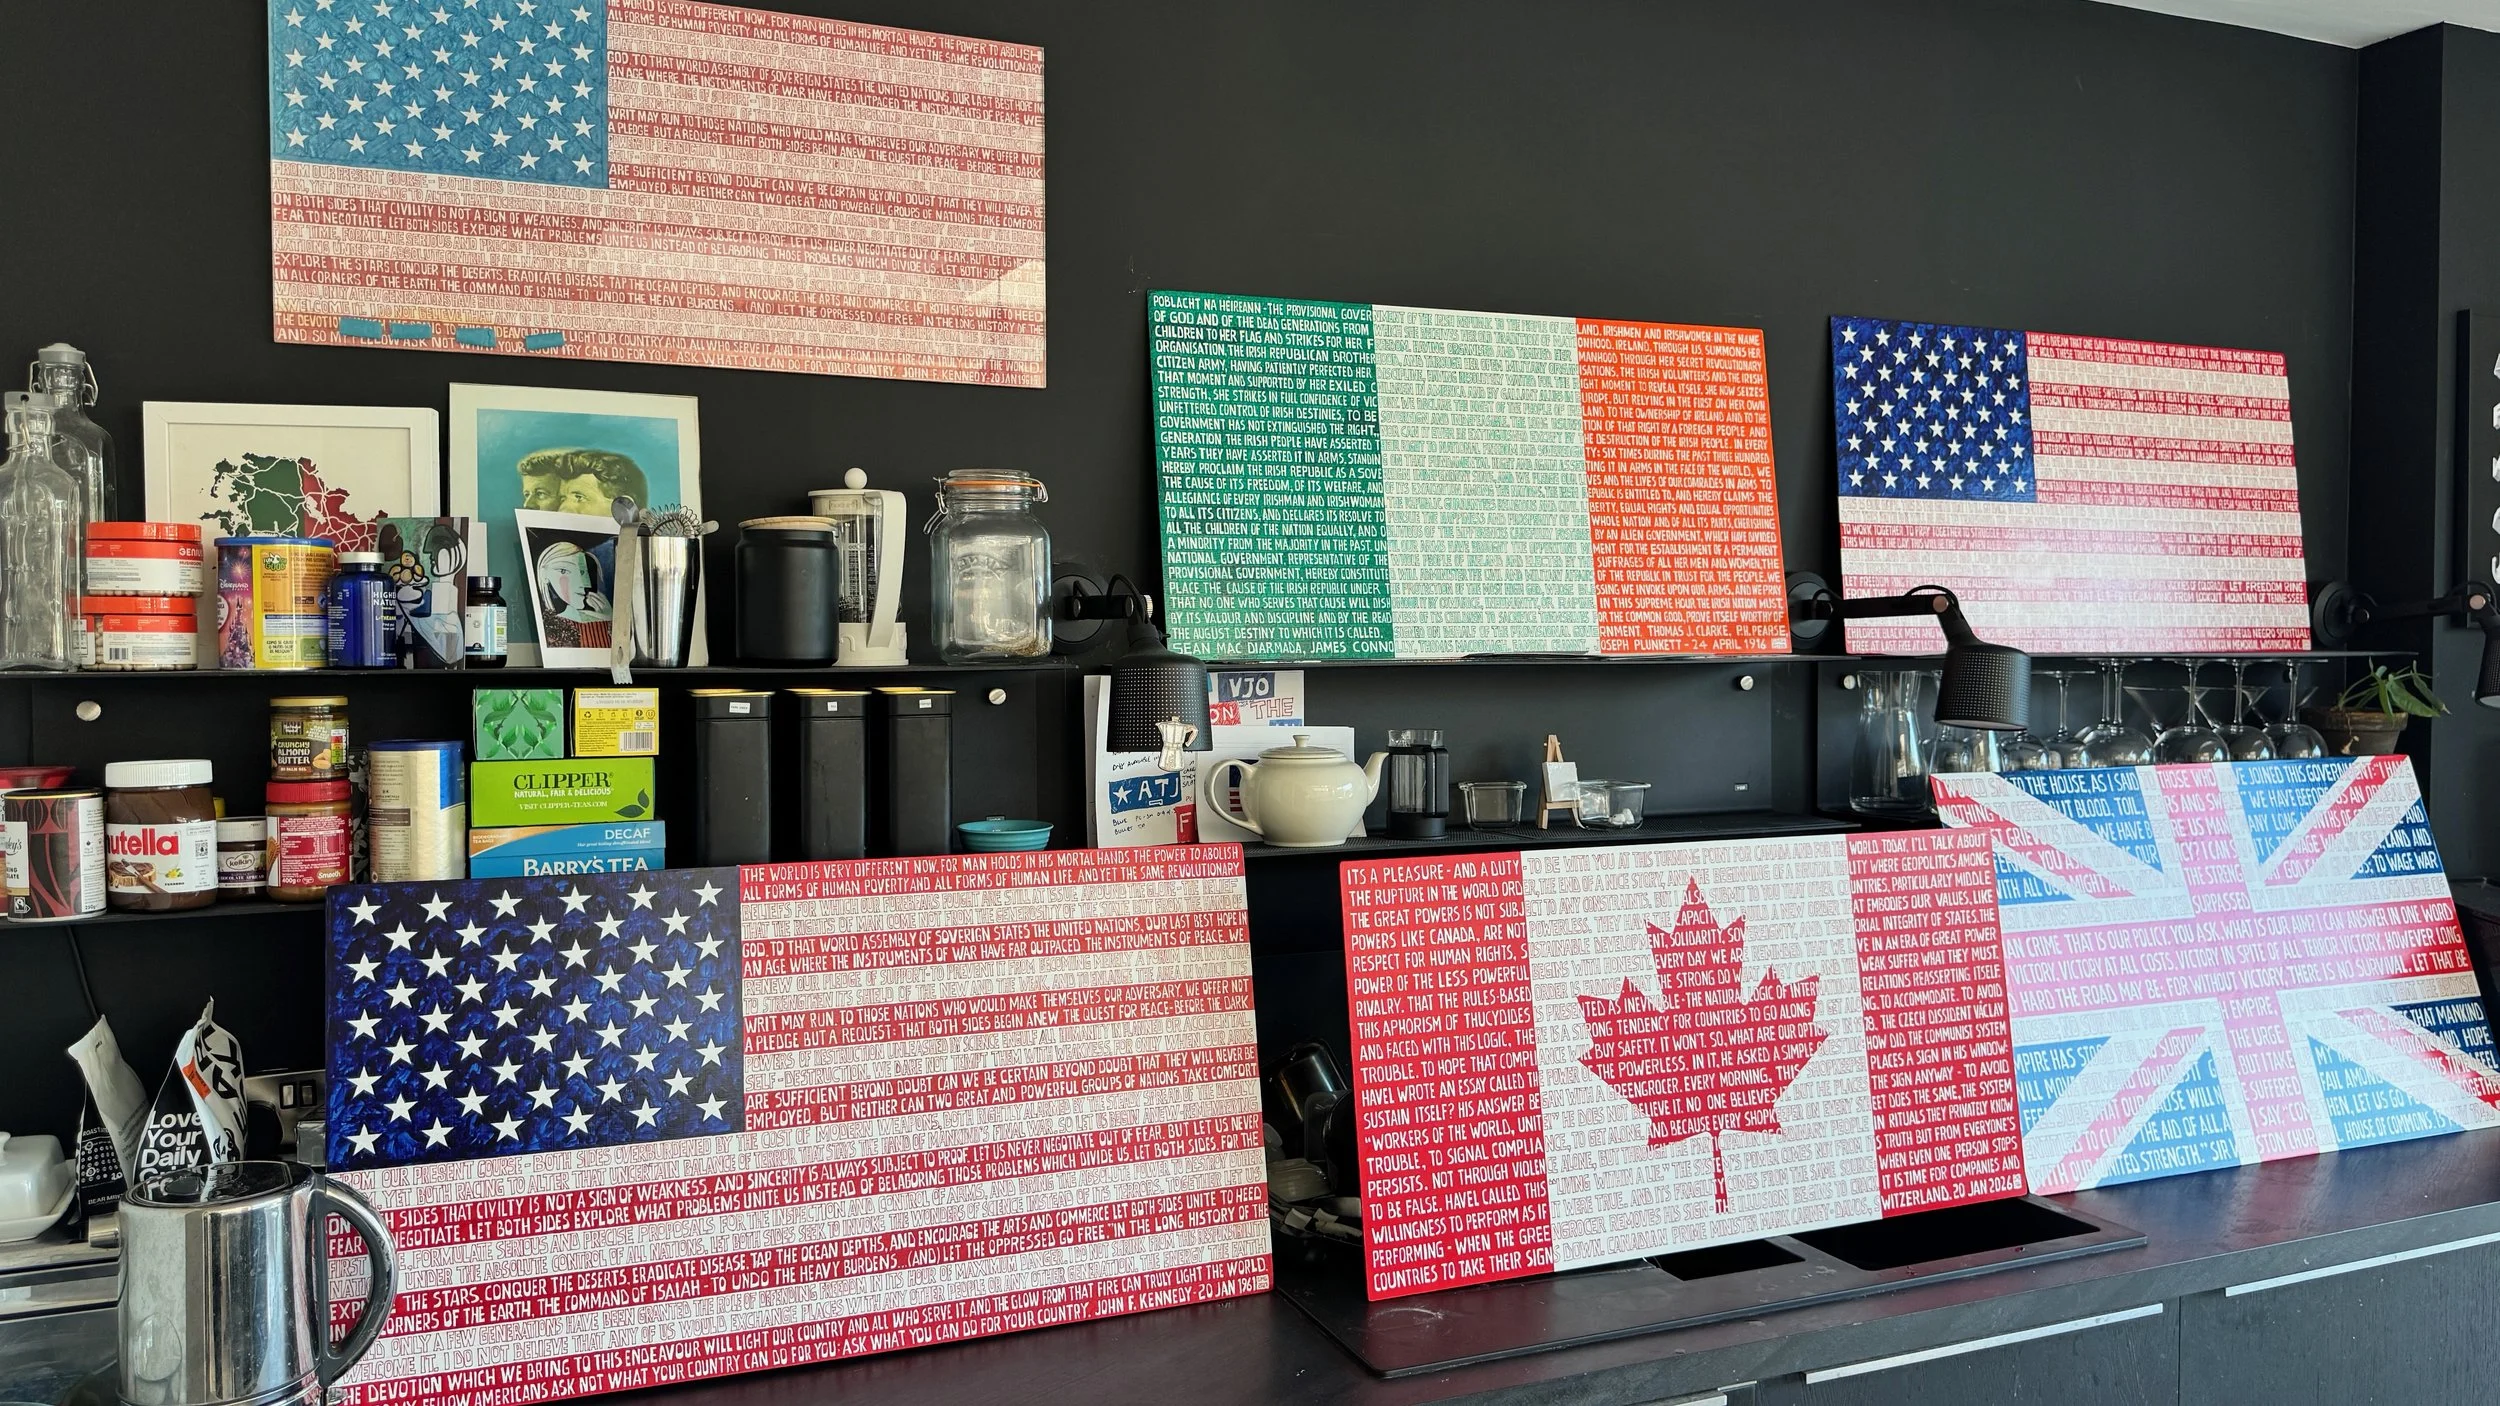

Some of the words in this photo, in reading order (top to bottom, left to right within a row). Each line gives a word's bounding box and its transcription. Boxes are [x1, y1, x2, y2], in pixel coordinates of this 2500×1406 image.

[676, 59, 708, 74] WORLD
[711, 62, 755, 79] ASSEMBLY
[771, 69, 820, 87] SOVEREIGN
[296, 194, 324, 209] BOTH
[327, 197, 356, 212] SIDES
[361, 199, 386, 214] THAT
[390, 201, 434, 217] CIVILITY
[275, 252, 326, 268] EXPLORE
[1153, 295, 1200, 310] POBLACHT
[1204, 299, 1216, 311] NA
[1286, 304, 1337, 319] PROVISIONAL
[1154, 325, 1203, 339] CHILDREN
[1219, 329, 1236, 341] HER
[1239, 330, 1261, 342] FLAG
[1285, 333, 1324, 346] STRIKES
[1326, 336, 1342, 348] FOR
[1619, 353, 1656, 366] THROUGH
[1658, 355, 1674, 367] HER
[1676, 356, 1704, 368] SECRET
[902, 367, 927, 378] JOHN
[1715, 425, 1744, 436] PEOPLE
[1748, 426, 1767, 437] AND
[2229, 581, 2241, 591] LET
[2245, 581, 2282, 591] FREEDOM
[2284, 582, 2303, 592] RING
[1647, 625, 1683, 636] THOMAS
[1216, 642, 1241, 654] MAC
[1309, 641, 1346, 653] JAMES
[1634, 639, 1681, 650] PLUNKETT
[1691, 639, 1707, 649] 24
[1712, 638, 1741, 649] APRIL
[1744, 638, 1766, 649] 1916
[1229, 677, 1269, 698] VJO
[1250, 697, 1294, 719] THE
[278, 749, 310, 757] ALMOND
[278, 756, 310, 765] BUTTER
[513, 772, 611, 790] CLIPPER
[1138, 777, 1179, 800] ATJ
[514, 790, 549, 798] NATURAL,
[574, 788, 612, 796] DELICIOUS
[605, 828, 651, 840] DECAF
[1930, 835, 1954, 850] TALK
[1956, 833, 1986, 849] ABOUT
[823, 863, 851, 878] VERY
[855, 860, 909, 877] DIFFERENT
[940, 858, 957, 873] FOR
[962, 856, 986, 871] MAN
[991, 855, 1021, 870] HOLDS
[1057, 852, 1095, 868] MORTAL
[1097, 850, 1129, 866] HANDS
[1154, 848, 1186, 863] POWER
[1202, 845, 1238, 860] ABOLISH
[318, 870, 342, 880] Smooth
[1347, 867, 1366, 884] ITS
[1370, 867, 1377, 883] A
[1383, 863, 1444, 882] PLEASURE
[1453, 862, 1476, 878] AND
[1490, 859, 1519, 876] DUTY
[2399, 905, 2422, 925] ONE
[2420, 902, 2454, 923] WORD
[861, 931, 916, 950] ASSEMBLY
[993, 923, 1030, 940] STATES
[1350, 931, 1396, 950] POWERS
[1401, 929, 1425, 947] LIKE
[1483, 924, 1503, 941] ARE
[1506, 922, 1526, 939] NOT
[2025, 934, 2062, 958] CRIME
[2063, 932, 2094, 954] THAT
[2094, 931, 2106, 951] IS
[2106, 929, 2131, 949] OUR
[2383, 927, 2436, 950] HOWEVER
[2434, 925, 2462, 946] LONG
[1655, 952, 1683, 969] EVERY
[1687, 950, 1707, 966] DAY
[1710, 948, 1726, 964] WE
[2057, 957, 2103, 981] VICTORY
[2118, 954, 2139, 975] ALL
[2410, 952, 2430, 972] LET
[2453, 949, 2469, 968] BE
[2019, 988, 2055, 1011] HARD
[2054, 986, 2080, 1008] THE
[2080, 983, 2118, 1006] ROAD
[1617, 1015, 1669, 1035] TENDENCY
[1673, 1013, 1691, 1030] FOR
[1694, 1007, 1746, 1027] COUNTRIES
[2434, 1002, 2485, 1024] MANKIND
[2248, 1076, 2302, 1101] SUFFERED
[148, 1110, 203, 1129] Love
[147, 1129, 202, 1148] Your
[140, 1146, 202, 1168] Daily
[1878, 1151, 1906, 1170] WHEN
[1908, 1147, 1932, 1166] EVEN
[1934, 1145, 1951, 1162] ONE
[1954, 1139, 1989, 1159] PERSON
[1991, 1135, 2018, 1153] STOPS
[1952, 1182, 1962, 1199] 20
[1966, 1178, 1987, 1196] JAN
[1988, 1174, 2012, 1193] 2026
[1373, 1263, 1438, 1292] COUNTRIES
[1440, 1261, 1455, 1281] TO
[1458, 1256, 1485, 1278] TAKE
[1489, 1250, 1521, 1273] THEIR
[1094, 1296, 1123, 1316] JOHN
[1139, 1285, 1192, 1309] KENNEDY
[1198, 1282, 1212, 1299] 20
[1214, 1279, 1235, 1296] JAN
[1237, 1276, 1256, 1293] 1961
[479, 1316, 562, 1345] GENERATIONS
[626, 1338, 699, 1367] ENDEAVOUR
[474, 1381, 547, 1406] AMERICANS
